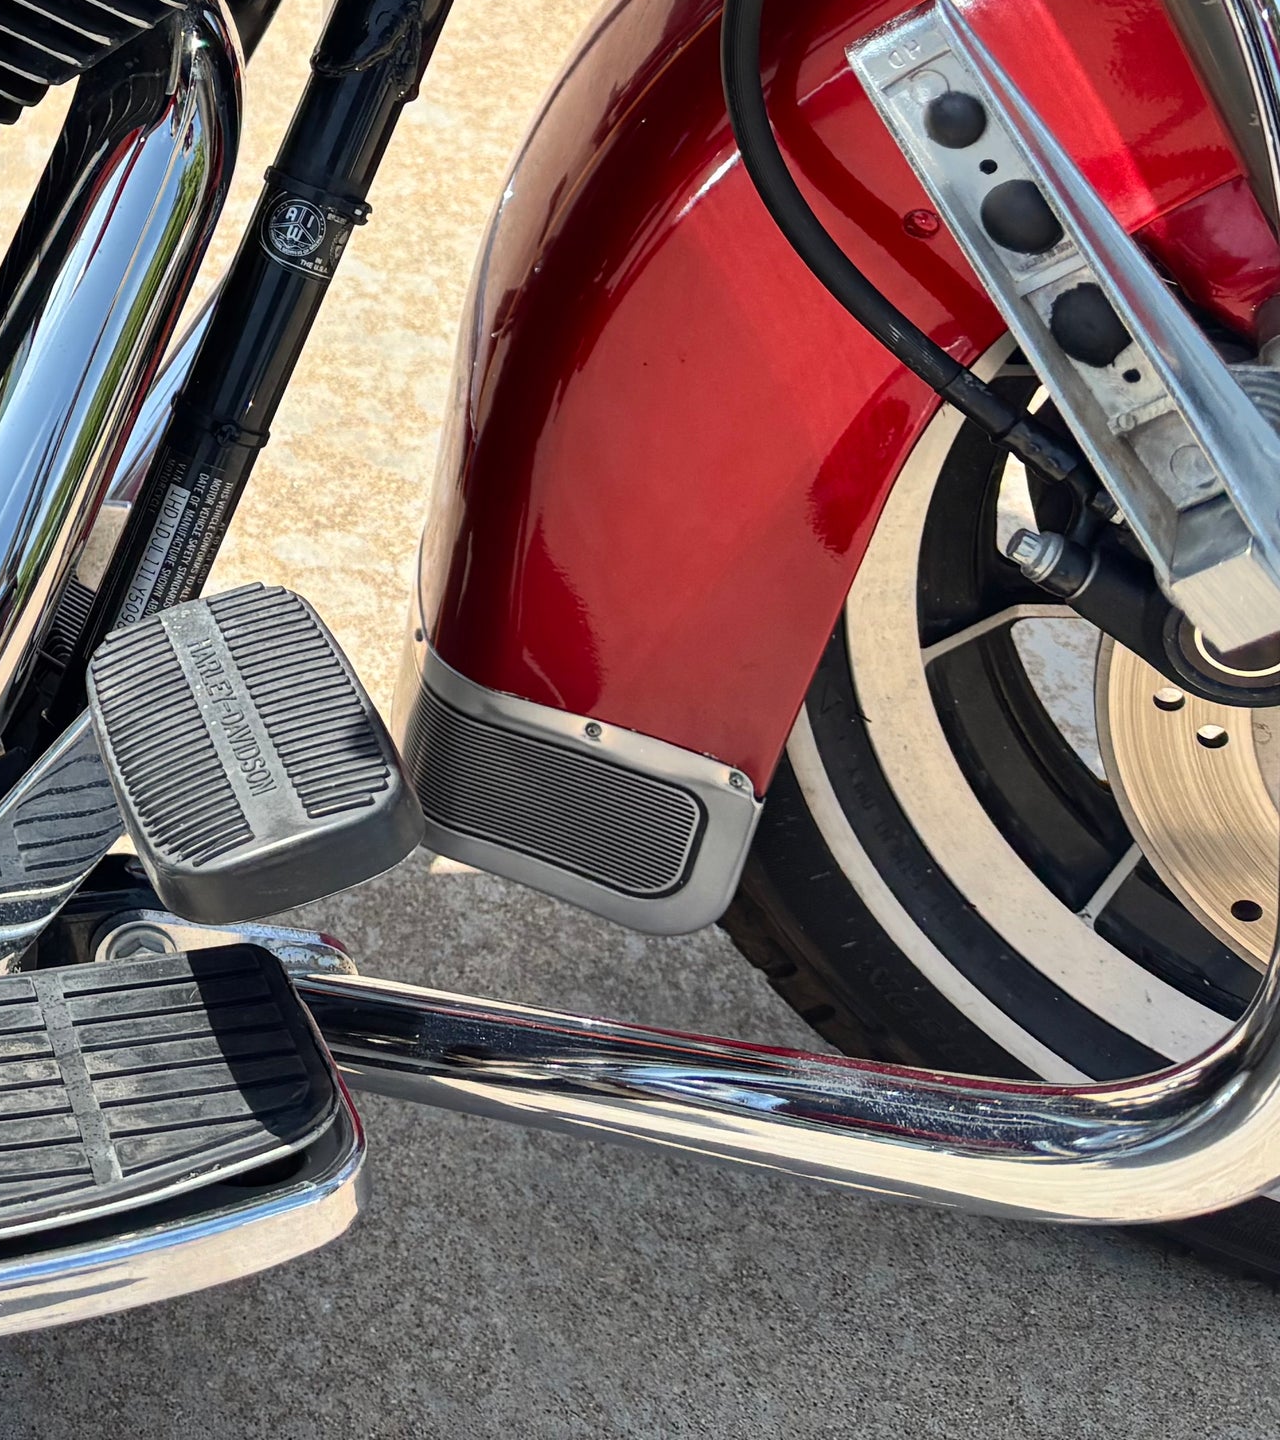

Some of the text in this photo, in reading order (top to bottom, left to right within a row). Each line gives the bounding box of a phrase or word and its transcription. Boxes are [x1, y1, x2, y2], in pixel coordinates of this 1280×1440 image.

[186, 494, 201, 508] OF
[192, 471, 210, 495] DATE
[161, 476, 223, 610] MOTOR VEHICLE SAFETY STANDARDS
[162, 507, 196, 567] MANUFACTURE
[178, 480, 234, 601] THIS VEHICLE CONFORMS TO ALL
[150, 566, 172, 598] SHOWN
[187, 637, 278, 797] HARLEY-DAVIDSON
